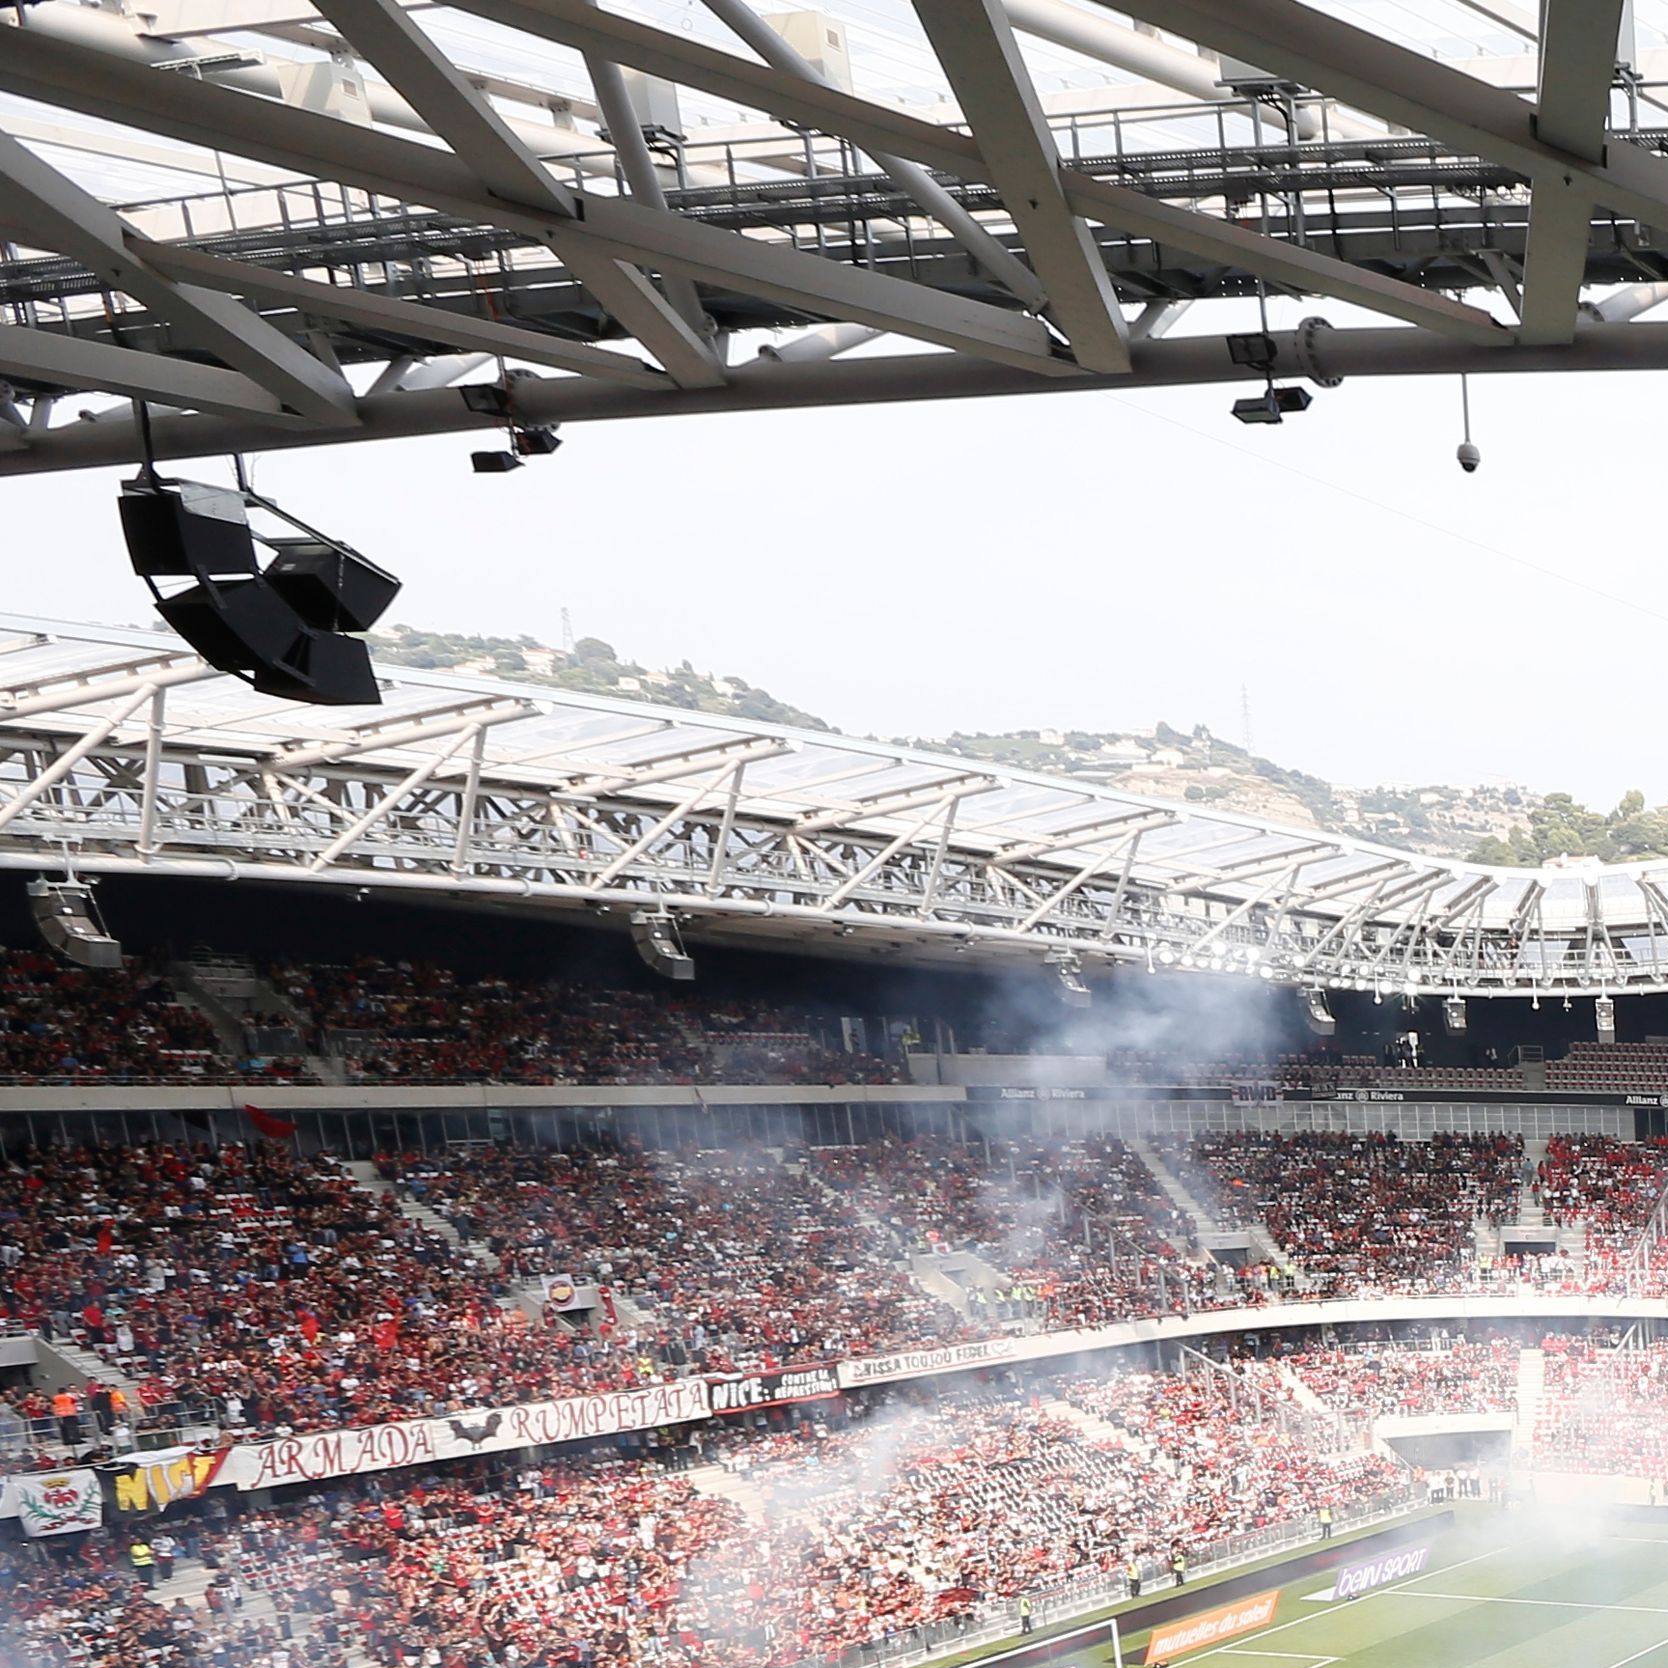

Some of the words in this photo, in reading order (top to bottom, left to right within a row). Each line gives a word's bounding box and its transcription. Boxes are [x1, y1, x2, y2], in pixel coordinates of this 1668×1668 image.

[1625, 1094, 1660, 1107] Allianz
[511, 1379, 710, 1444] RUMPETATA
[251, 1422, 433, 1490] ARMADA
[1382, 1547, 1428, 1583] SPORT
[1152, 1621, 1219, 1656] mutuelles
[1219, 1612, 1237, 1634] du
[1236, 1598, 1273, 1631] soleil
